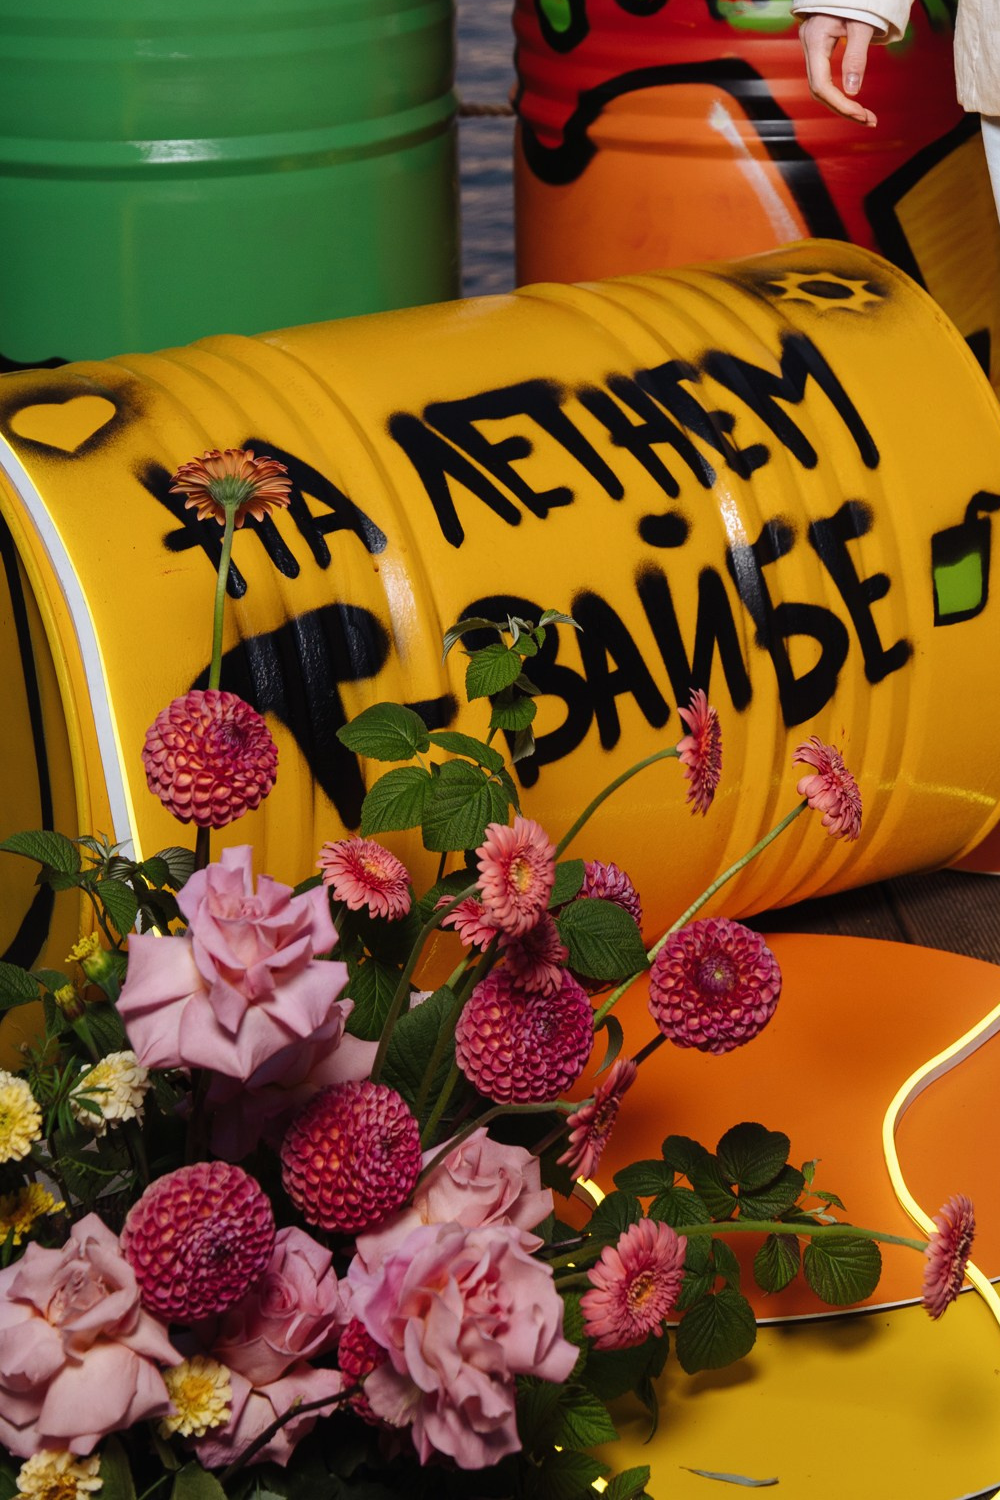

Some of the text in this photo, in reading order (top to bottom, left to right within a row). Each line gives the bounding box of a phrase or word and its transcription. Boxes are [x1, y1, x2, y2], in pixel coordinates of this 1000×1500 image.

[136, 330, 880, 598] НА ЛЕТНЕМ
[457, 499, 914, 788] ВАЙБЕ
